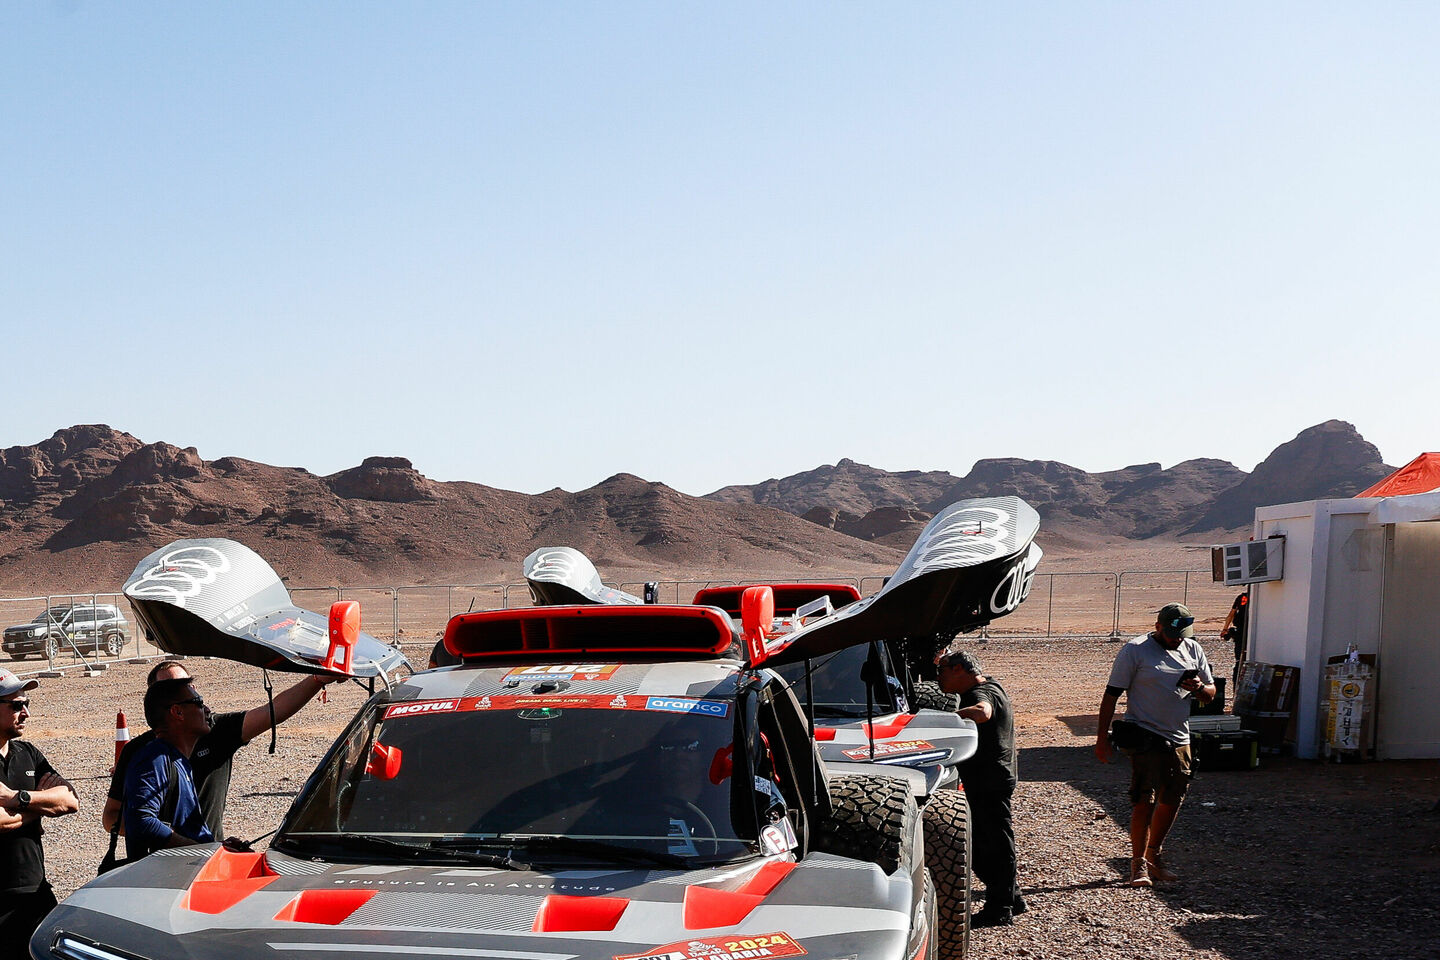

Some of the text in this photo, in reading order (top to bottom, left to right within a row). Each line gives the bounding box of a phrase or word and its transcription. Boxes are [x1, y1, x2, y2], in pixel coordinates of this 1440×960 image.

[521, 664, 606, 674] 207
[390, 702, 454, 716] MOTUL
[652, 700, 722, 713] aramco
[506, 883, 615, 891] Attitude
[725, 935, 788, 953] 2024
